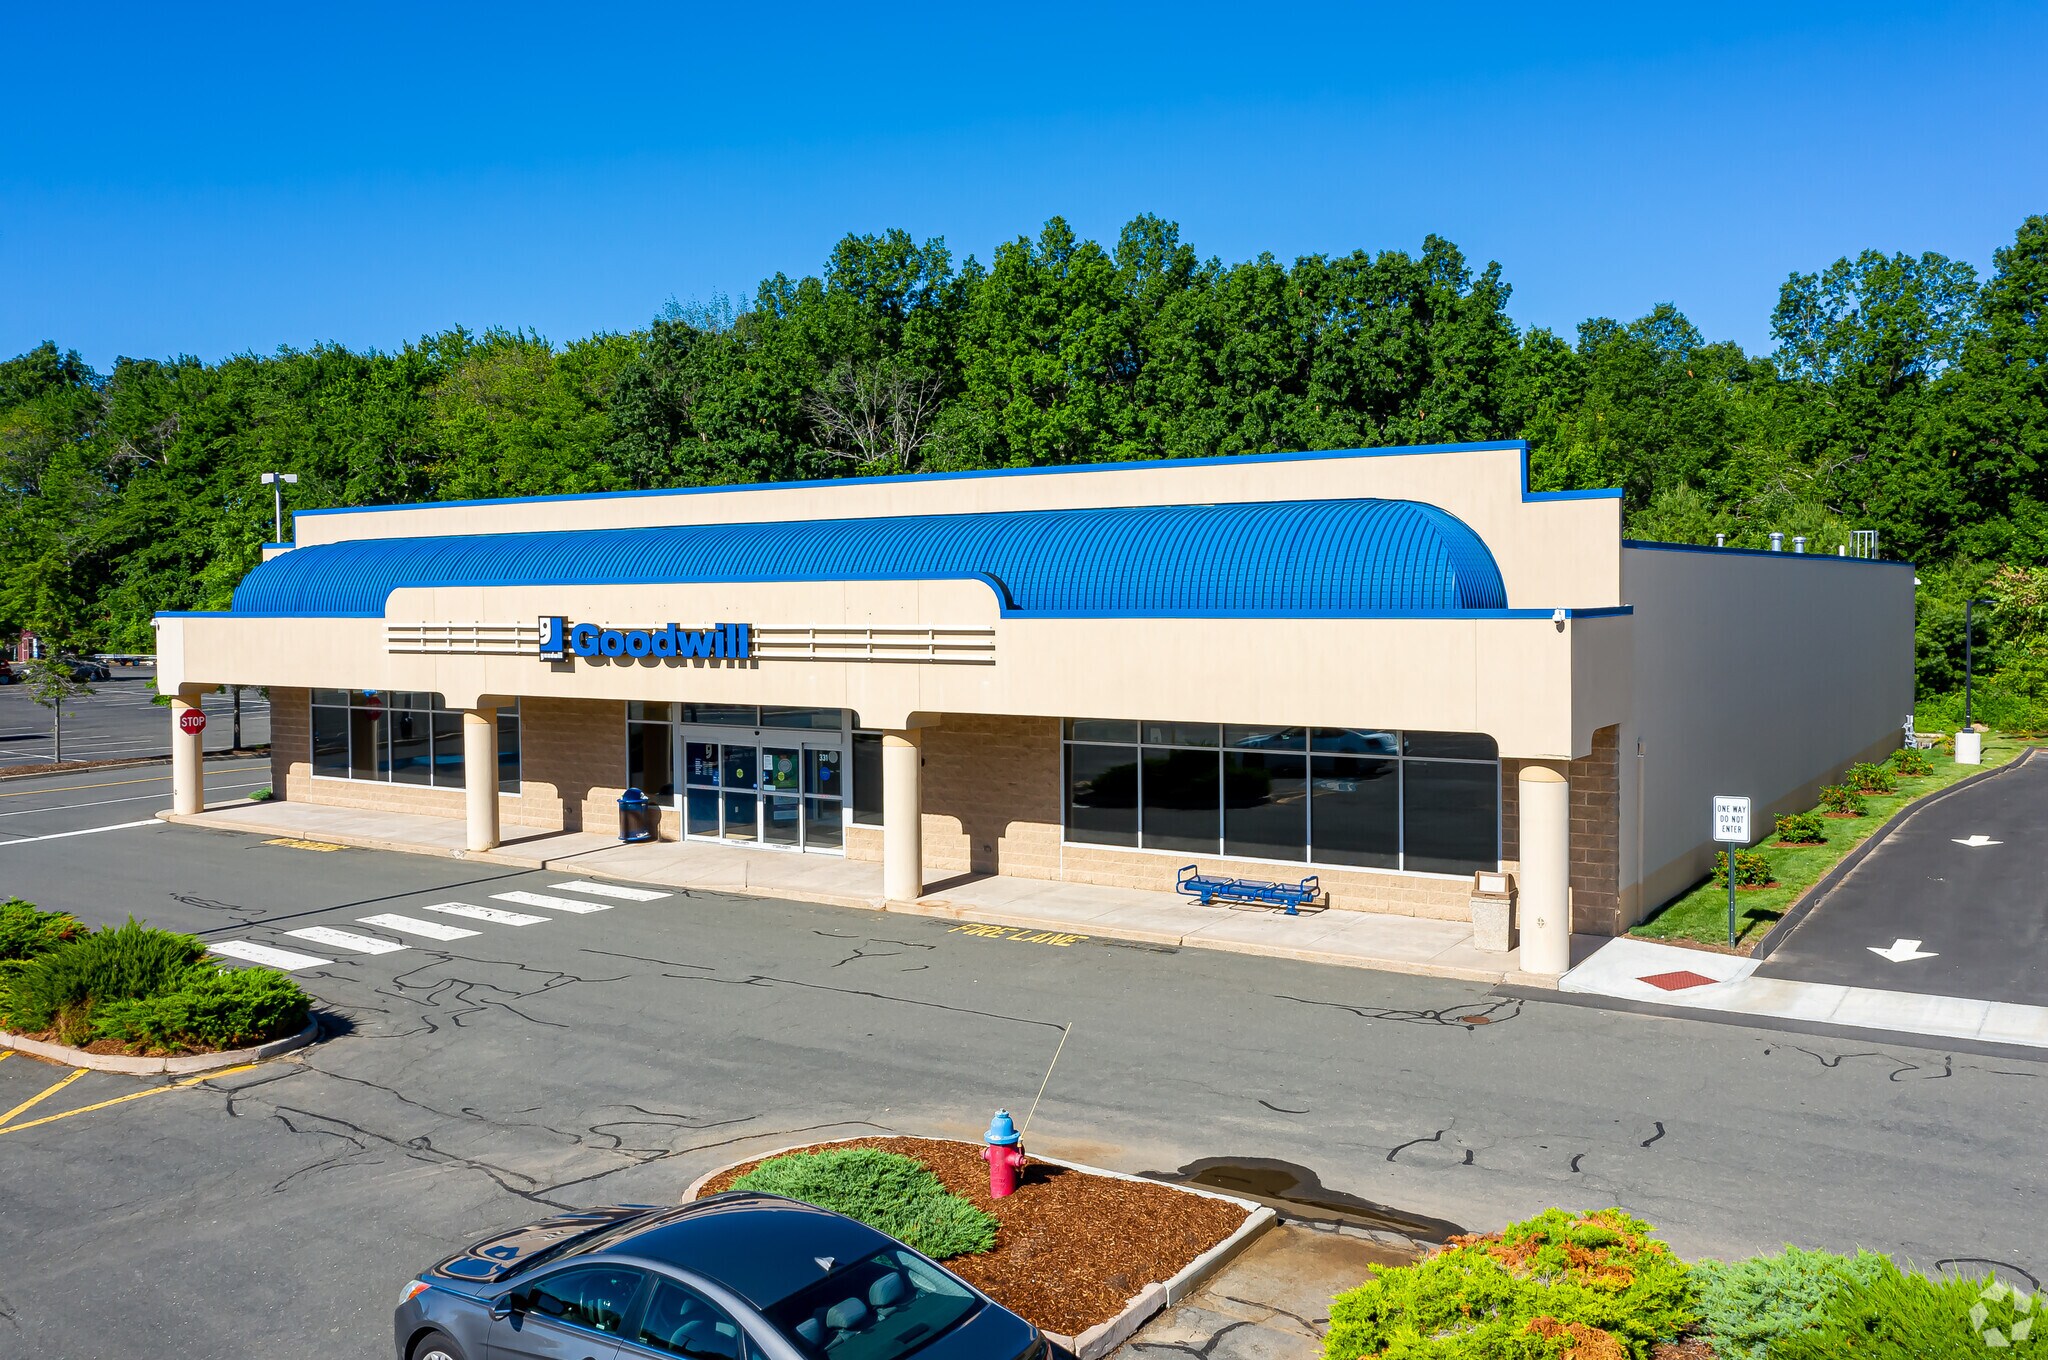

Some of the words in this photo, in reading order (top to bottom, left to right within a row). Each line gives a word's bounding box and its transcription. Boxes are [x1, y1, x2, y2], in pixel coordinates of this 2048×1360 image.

[571, 623, 749, 658] Goodwill
[182, 716, 204, 726] STOP
[1718, 804, 1730, 812] ONE
[1720, 814, 1728, 822] DO
[1732, 816, 1744, 824] NOT
[1722, 825, 1742, 833] ENTER
[947, 923, 1019, 938] FIRE
[1006, 929, 1090, 947] LANE
